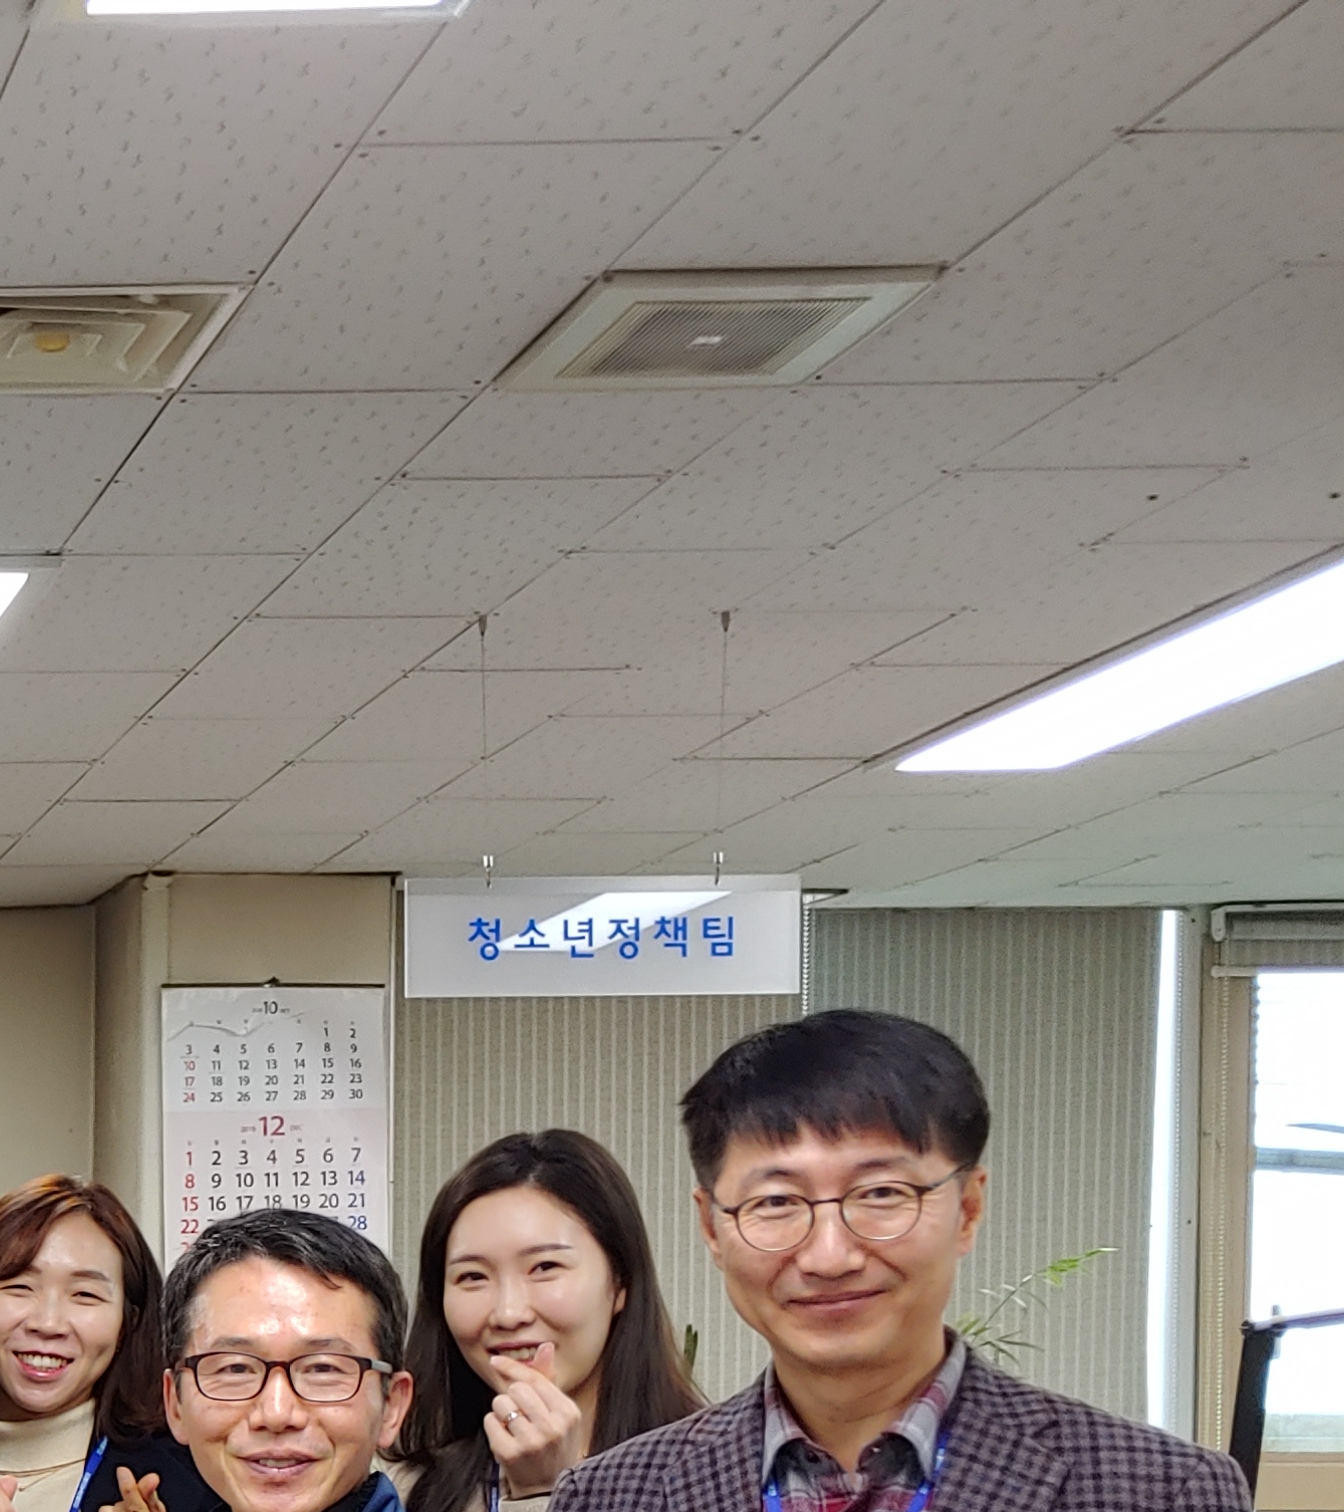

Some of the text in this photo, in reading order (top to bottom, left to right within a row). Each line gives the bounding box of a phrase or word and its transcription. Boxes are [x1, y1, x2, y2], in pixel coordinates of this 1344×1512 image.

[467, 916, 735, 961] 청소년정책팀
[183, 1057, 362, 1071] 10 11 12 13 14 15 16
[184, 1072, 363, 1087] 17 18 19 20 21 22 23
[183, 1088, 364, 1103] 24 25 26 27 28 29 30
[259, 1116, 285, 1136] 12
[186, 1147, 362, 1166] 1 2 3 4 5 6 7
[184, 1170, 366, 1189] 8 9 10 11 12 13 14
[182, 1192, 365, 1212] 15 16 17 18 19 20 21
[180, 1215, 368, 1234] 22 28
